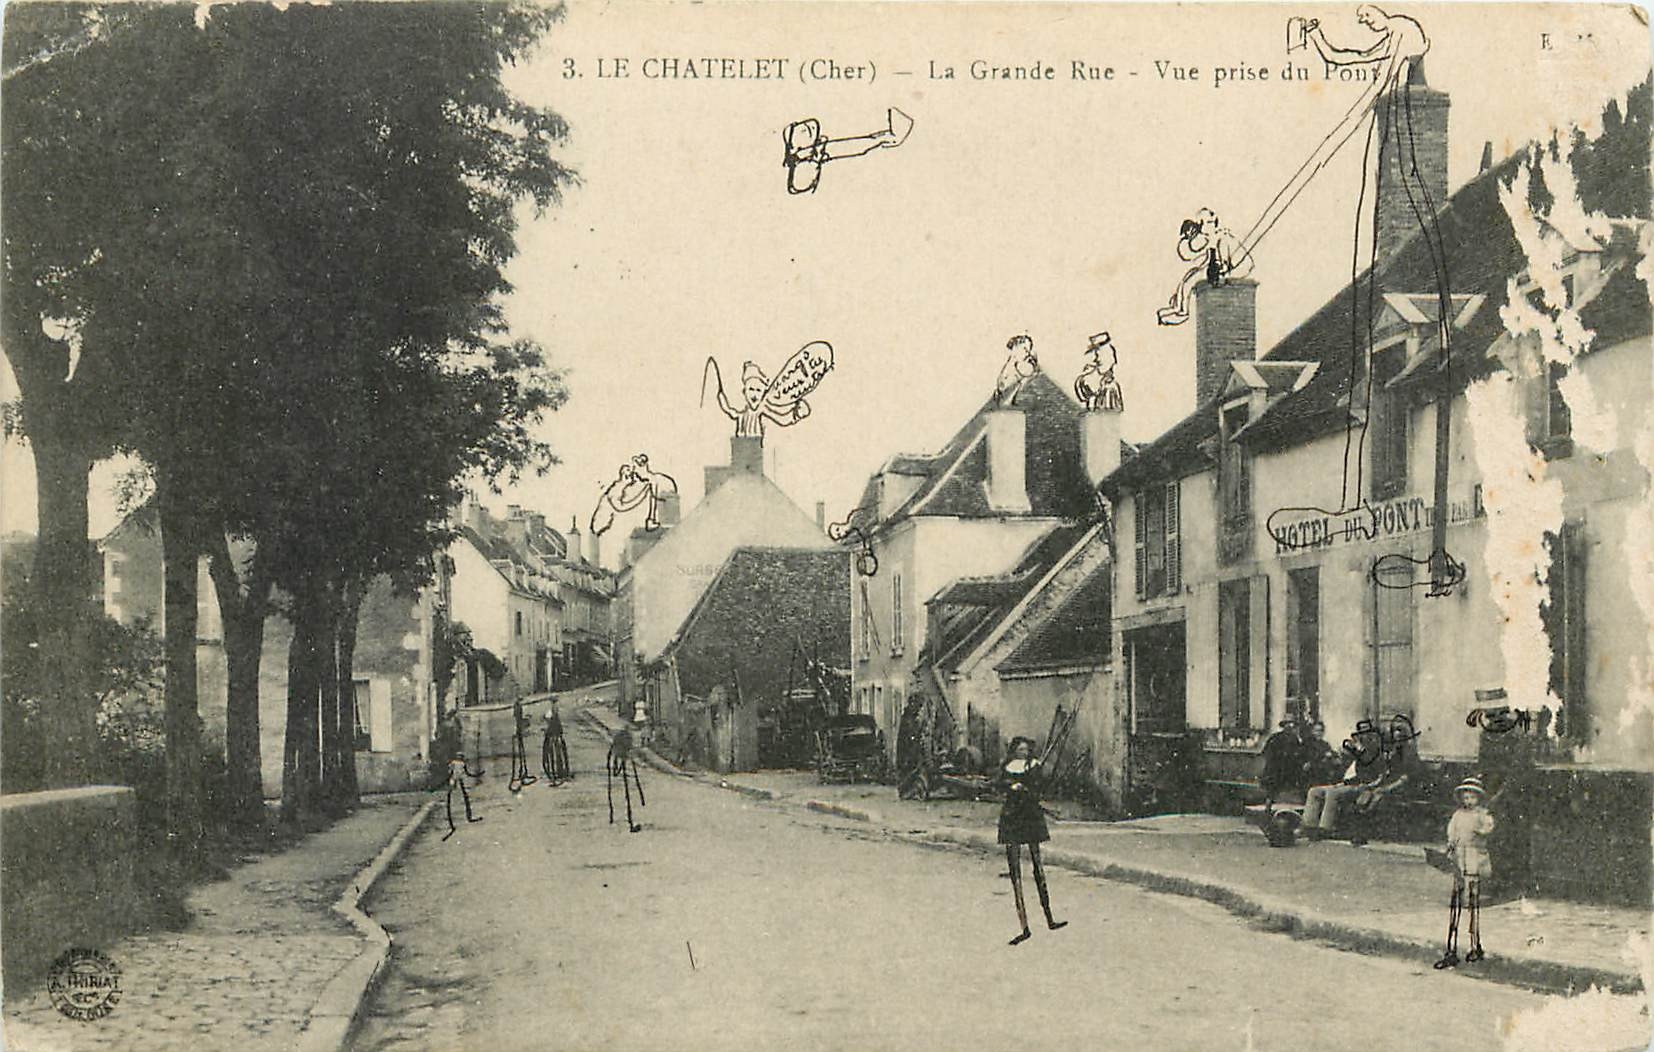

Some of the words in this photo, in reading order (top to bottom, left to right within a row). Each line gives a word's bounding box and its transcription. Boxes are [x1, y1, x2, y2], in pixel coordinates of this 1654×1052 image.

[1274, 517, 1334, 554] HOTEL
[1343, 516, 1363, 543] DU
[1374, 497, 1425, 537] PONT
